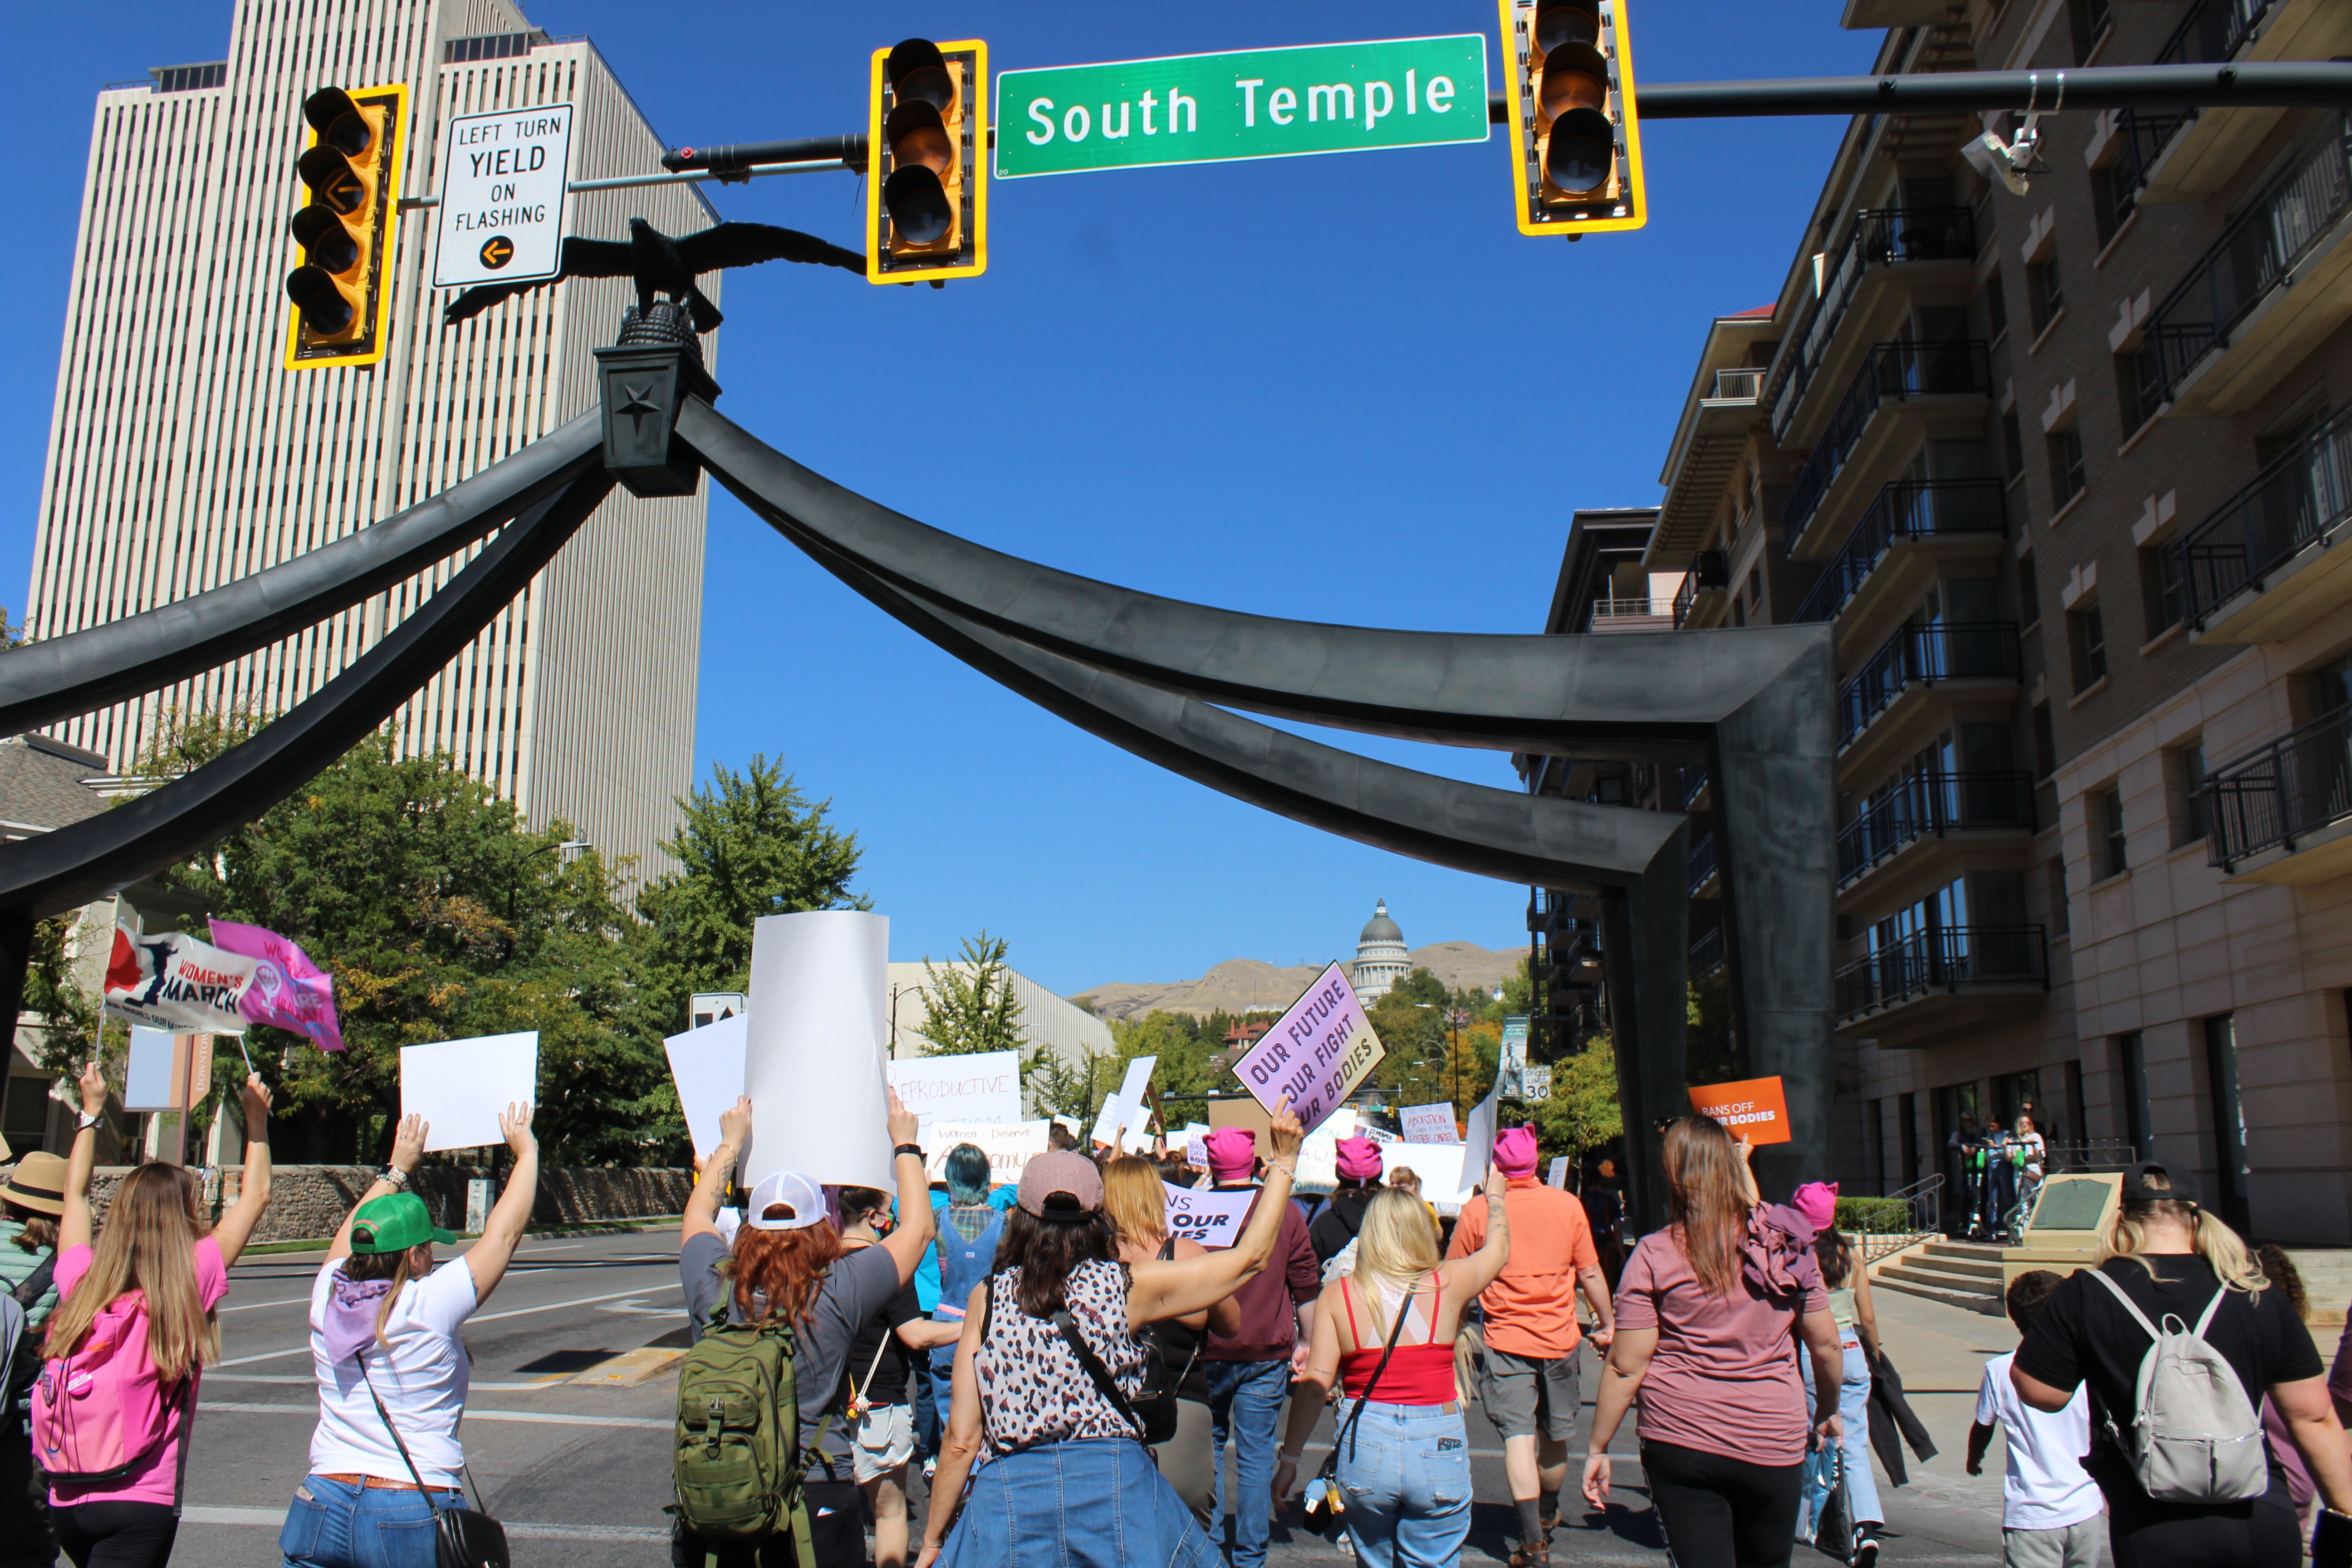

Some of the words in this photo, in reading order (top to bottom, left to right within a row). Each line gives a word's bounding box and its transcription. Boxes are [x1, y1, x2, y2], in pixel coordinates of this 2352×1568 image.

[1025, 87, 1197, 147] South
[1235, 67, 1455, 132] Temple
[459, 123, 503, 145] LEFT
[514, 116, 562, 139] TURN
[470, 145, 545, 178] YIELD
[491, 183, 516, 202] ON
[455, 204, 546, 232] FLASHING
[178, 959, 244, 989] WOMEN'S
[162, 975, 238, 1014] MARCH
[151, 1014, 167, 1028] OUR
[1250, 1043, 1291, 1085] OUR
[1288, 980, 1345, 1047] FUTURE
[196, 1033, 209, 1091] DOWNTOW
[1281, 1063, 1316, 1104] OUR
[1314, 1014, 1354, 1068] FIGHT
[1300, 1096, 1321, 1127] UR
[1324, 1038, 1372, 1102] BODIES
[1526, 1085, 1548, 1098] 30
[1702, 1104, 1731, 1116] BANS
[1731, 1102, 1754, 1113] OFF
[1407, 1113, 1446, 1127] ABORTION
[1729, 1110, 1776, 1126] BODIES
[938, 1128, 977, 1139] Women
[991, 1128, 1030, 1139] Deserve
[1190, 1142, 1206, 1151] BAN
[1190, 1149, 1205, 1157] OFF
[1190, 1156, 1206, 1164] BOD
[1299, 1148, 1337, 1166] AWS
[1299, 1165, 1331, 1176] BOUT
[1295, 1181, 1332, 1192] OMEN
[1166, 1194, 1193, 1211] NS
[1172, 1214, 1230, 1227] OUR
[1171, 1229, 1210, 1240] IES
